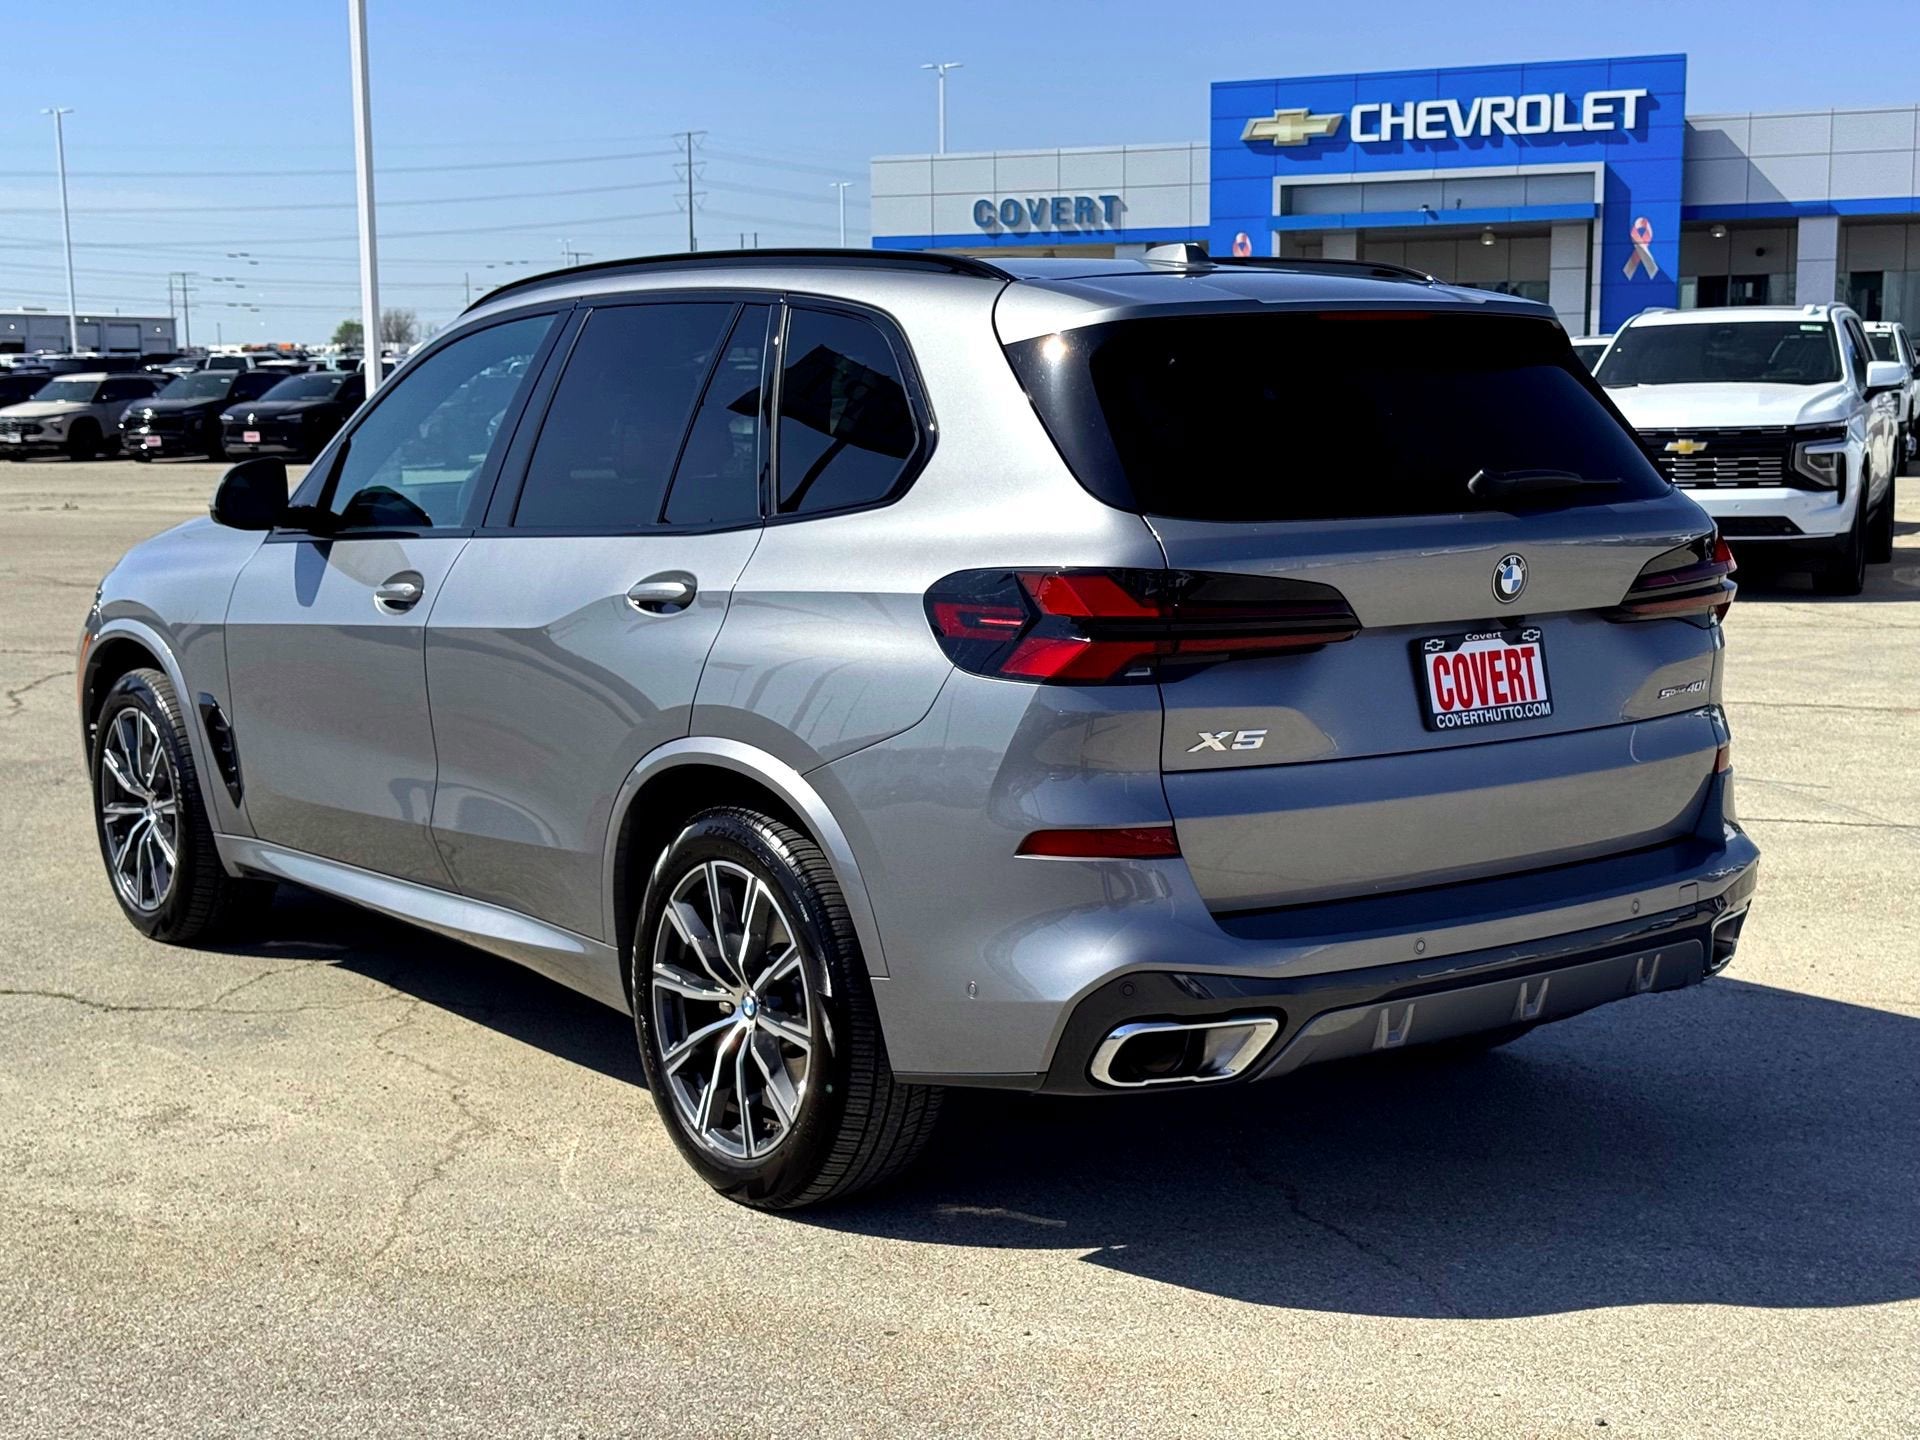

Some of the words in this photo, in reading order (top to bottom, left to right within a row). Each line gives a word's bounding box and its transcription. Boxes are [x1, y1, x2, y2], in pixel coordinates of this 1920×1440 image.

[1350, 89, 1647, 143] CHEVROLET
[974, 195, 1121, 227] COVERT
[1465, 631, 1502, 641] Covert
[1433, 647, 1538, 711] COVERT
[1436, 702, 1551, 728] COVERTHUTTO.COM
[1187, 729, 1268, 752] X5
